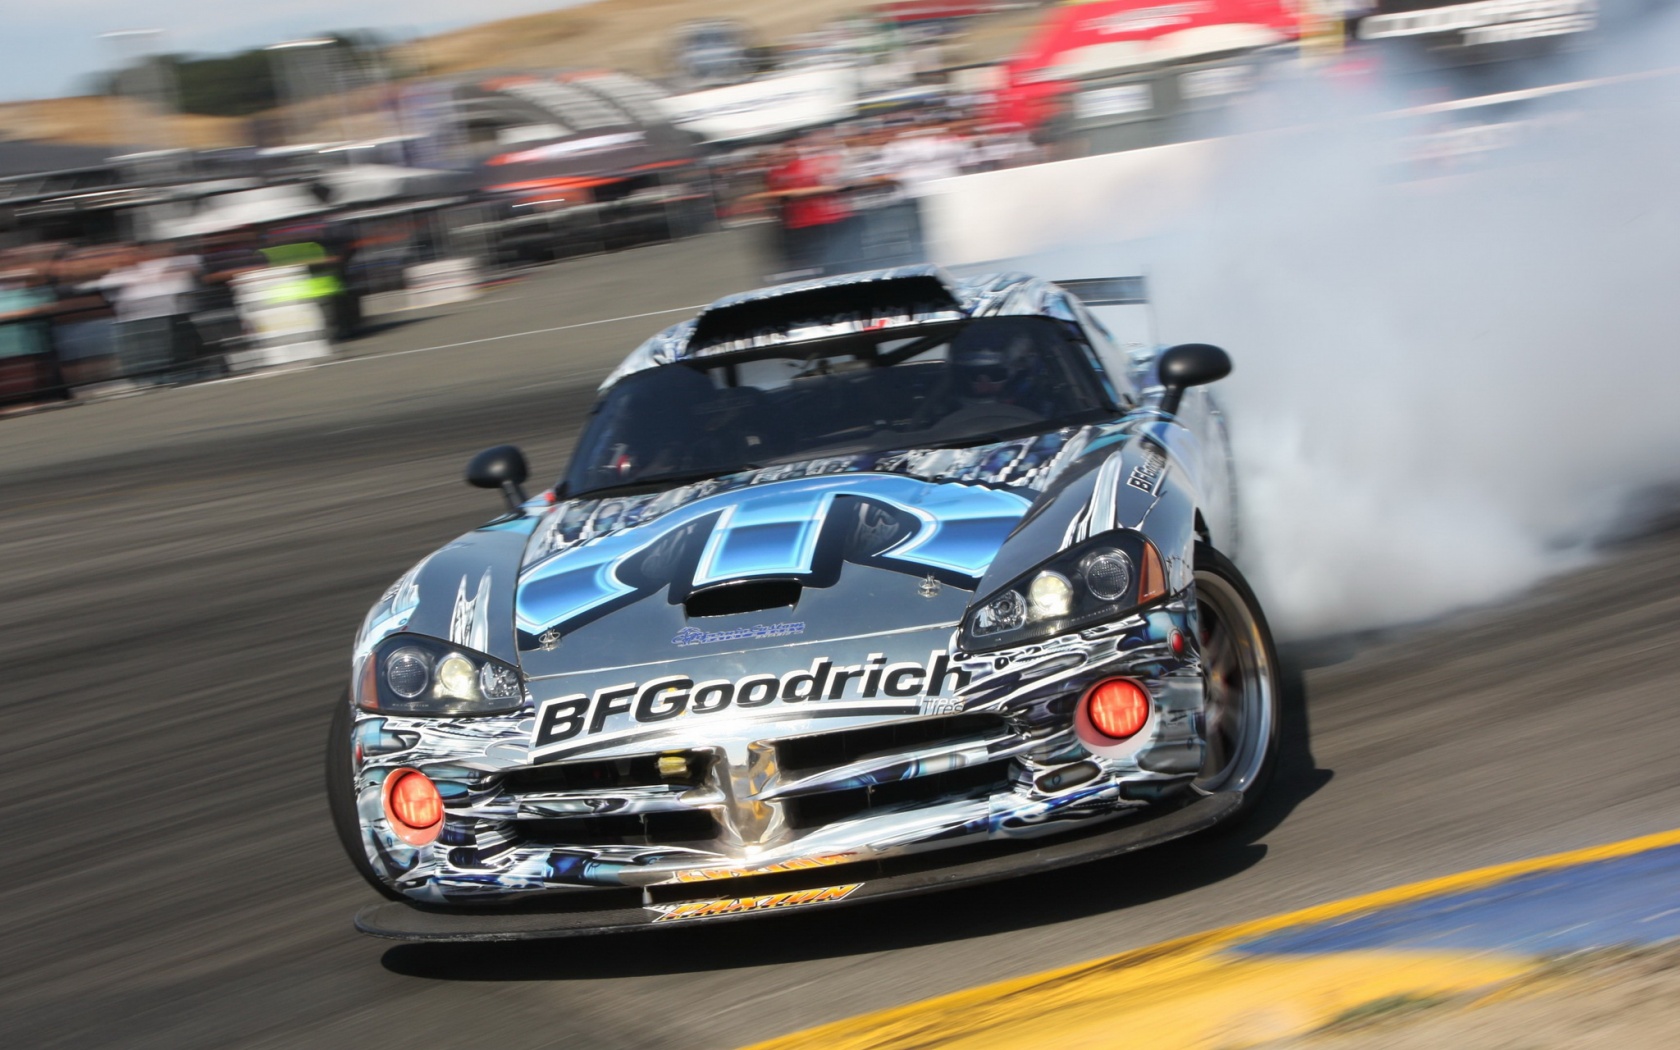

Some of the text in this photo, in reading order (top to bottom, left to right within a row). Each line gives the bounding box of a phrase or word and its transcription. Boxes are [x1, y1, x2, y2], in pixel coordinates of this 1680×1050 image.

[534, 649, 972, 748] BFGoodrich
[920, 695, 965, 716] Tires
[665, 884, 859, 918] PAXTON
